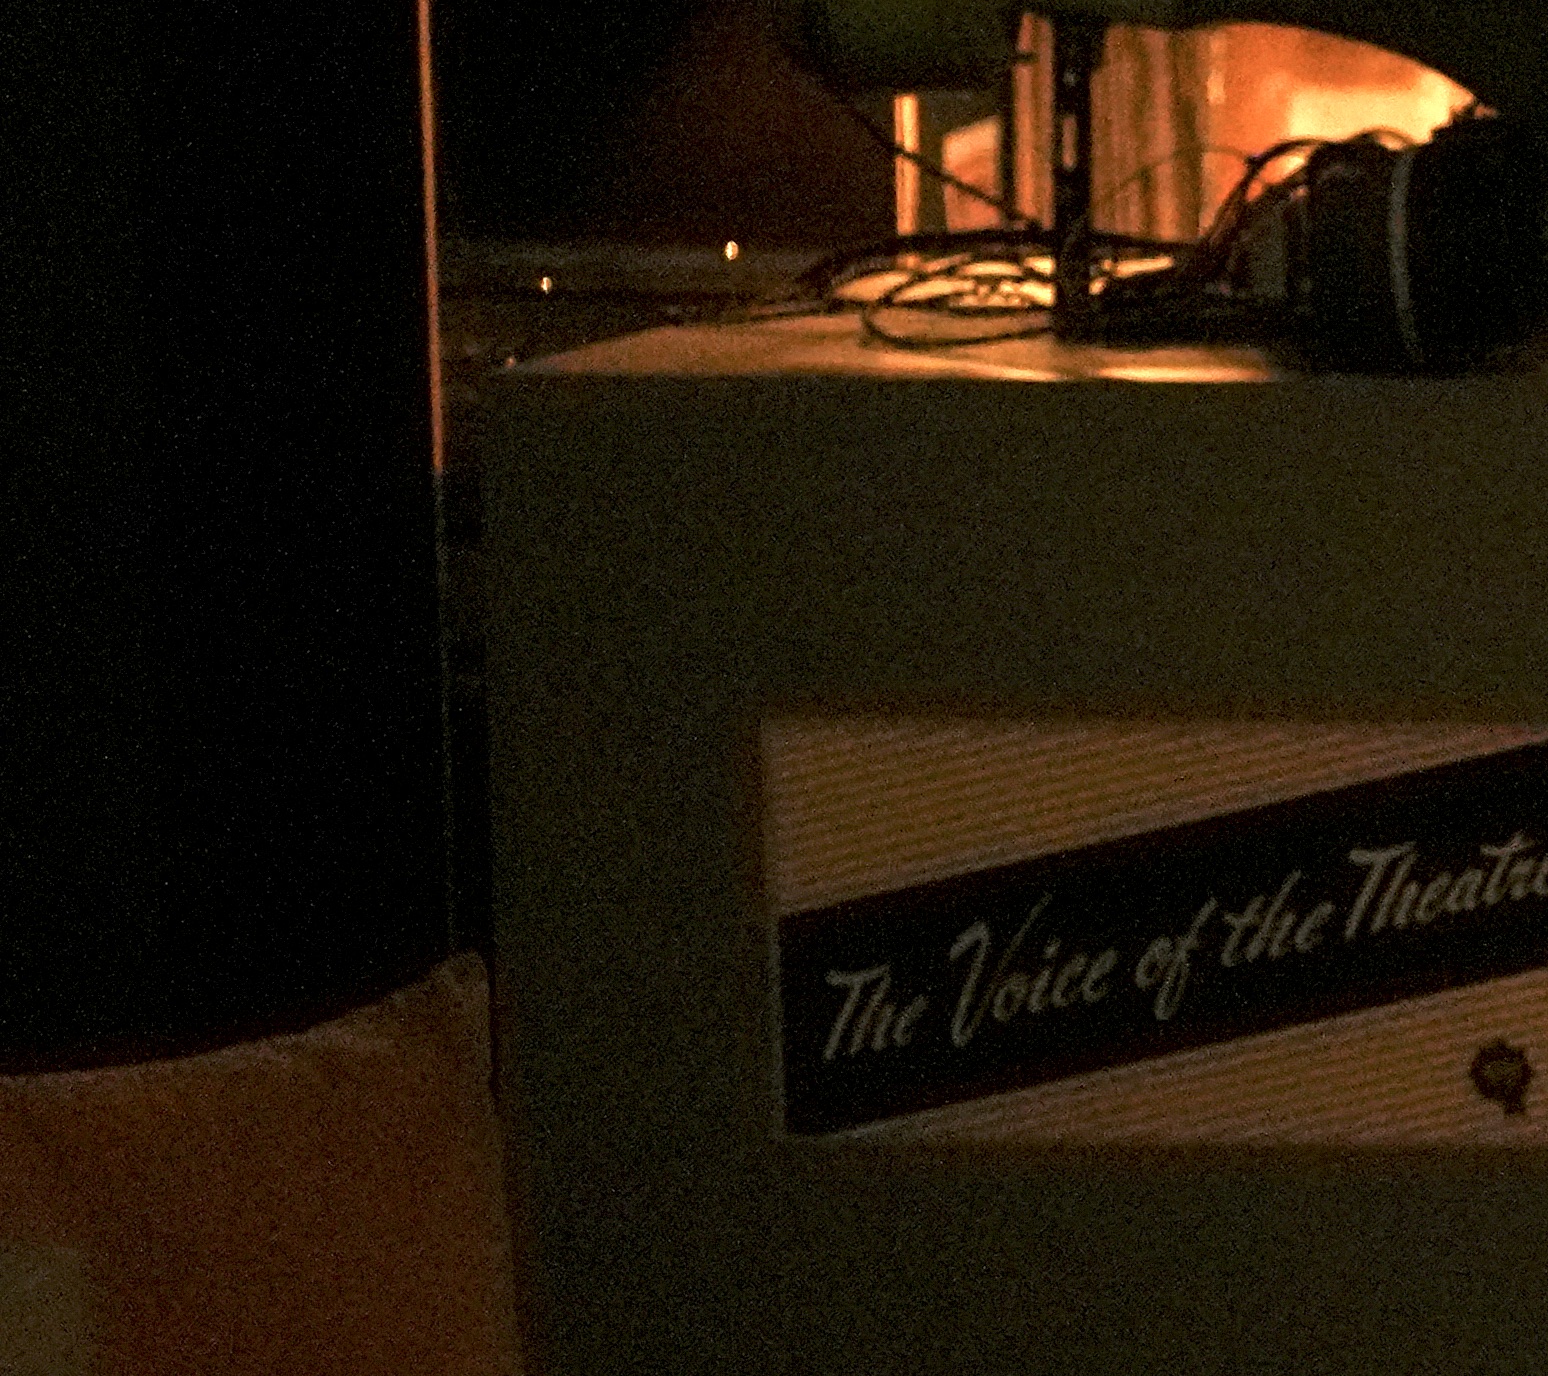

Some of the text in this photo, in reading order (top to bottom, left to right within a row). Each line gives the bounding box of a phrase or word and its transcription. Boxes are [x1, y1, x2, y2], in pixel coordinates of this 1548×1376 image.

[823, 964, 930, 1062] The
[949, 892, 1119, 1049] Voice
[1134, 897, 1218, 1022] of
[1219, 869, 1335, 968] the
